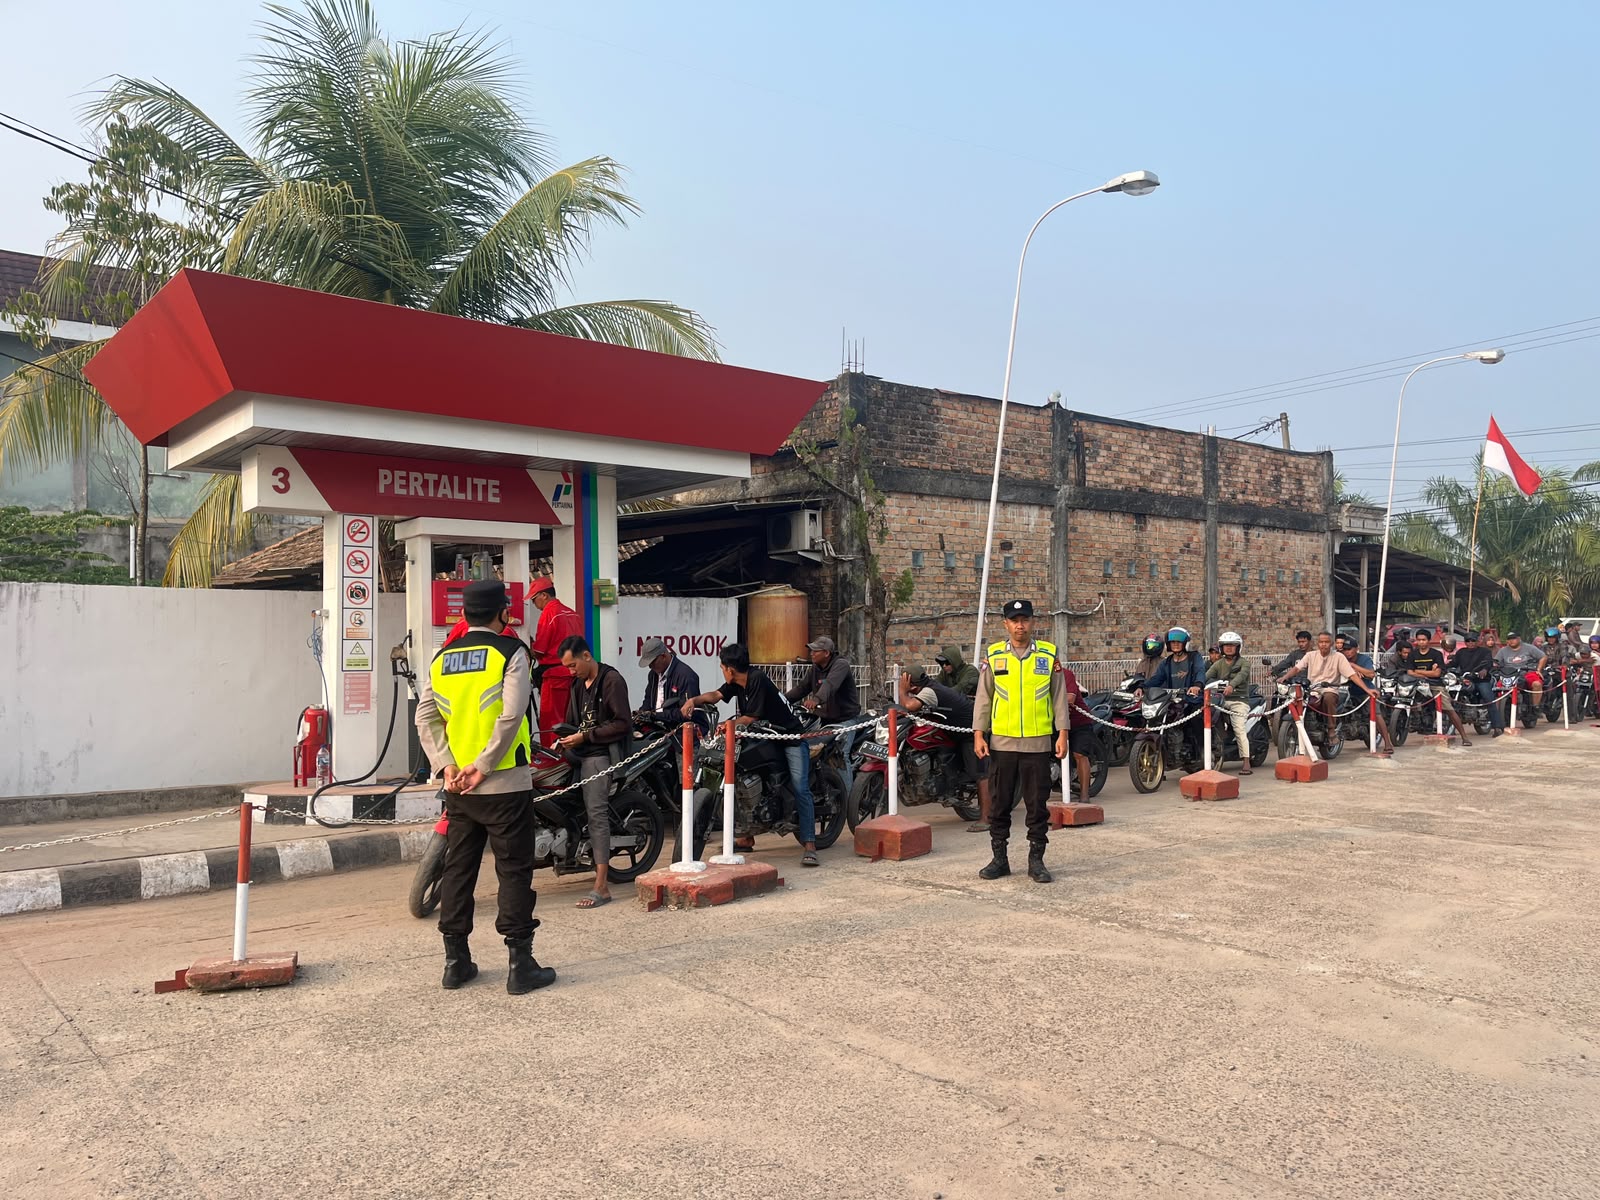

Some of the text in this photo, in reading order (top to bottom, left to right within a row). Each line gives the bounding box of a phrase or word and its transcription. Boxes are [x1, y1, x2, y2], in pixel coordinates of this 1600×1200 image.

[271, 467, 291, 494] 3
[378, 468, 501, 503] PERTALITE
[636, 635, 728, 657] MROKOK
[442, 650, 487, 674] POLISI
